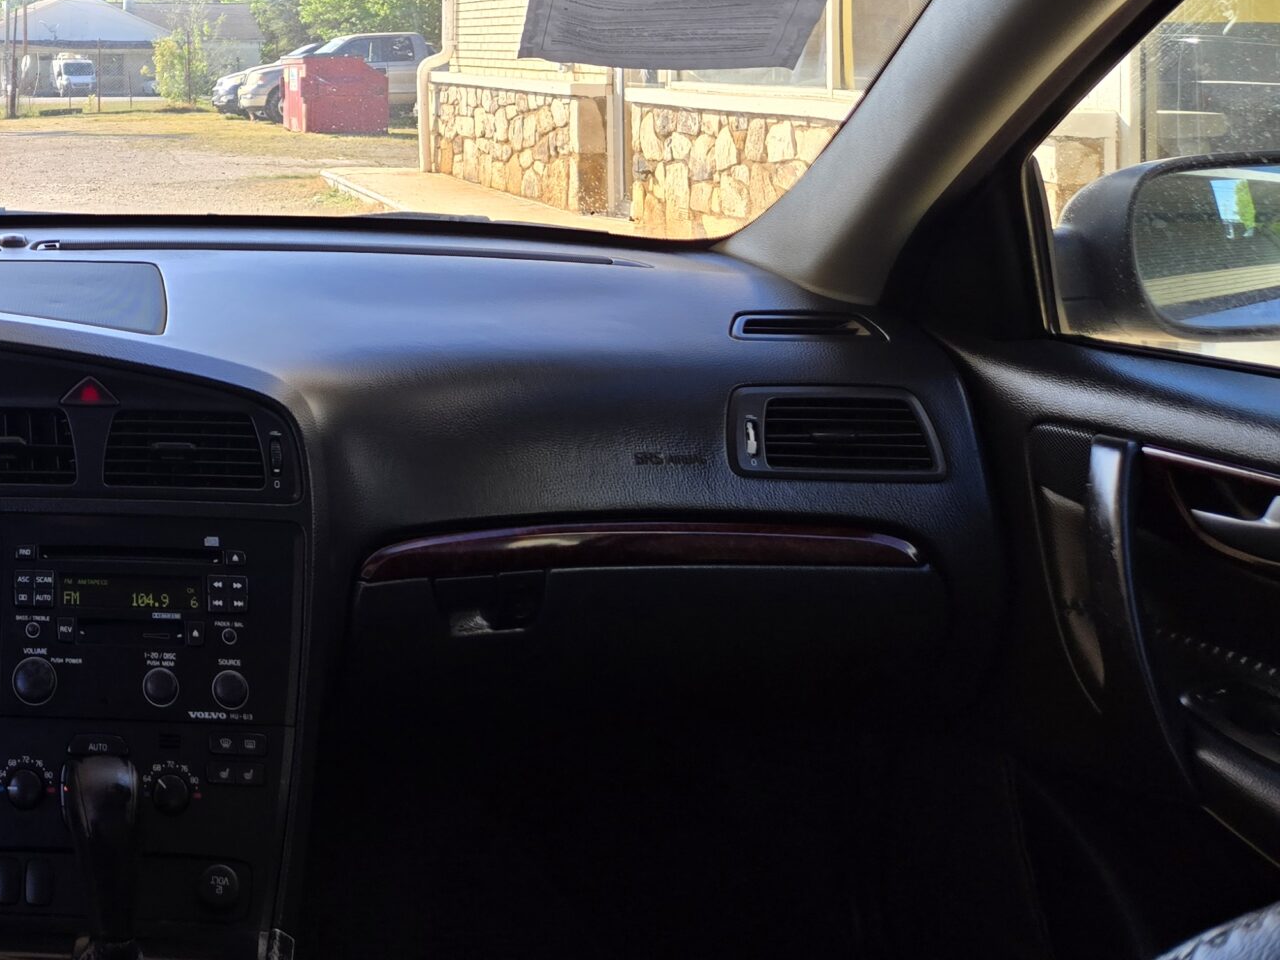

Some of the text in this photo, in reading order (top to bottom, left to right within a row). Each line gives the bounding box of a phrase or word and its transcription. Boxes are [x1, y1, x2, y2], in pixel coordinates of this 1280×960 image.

[35, 576, 53, 584] SCAN
[35, 594, 52, 602] AUTO
[63, 590, 170, 608] FM 104.9
[190, 595, 199, 609] 6
[59, 625, 73, 633] REV
[22, 647, 48, 656] VOLUME
[217, 658, 242, 667] SOURCE
[188, 711, 227, 720] VOLVO
[88, 743, 108, 751] AUTO
